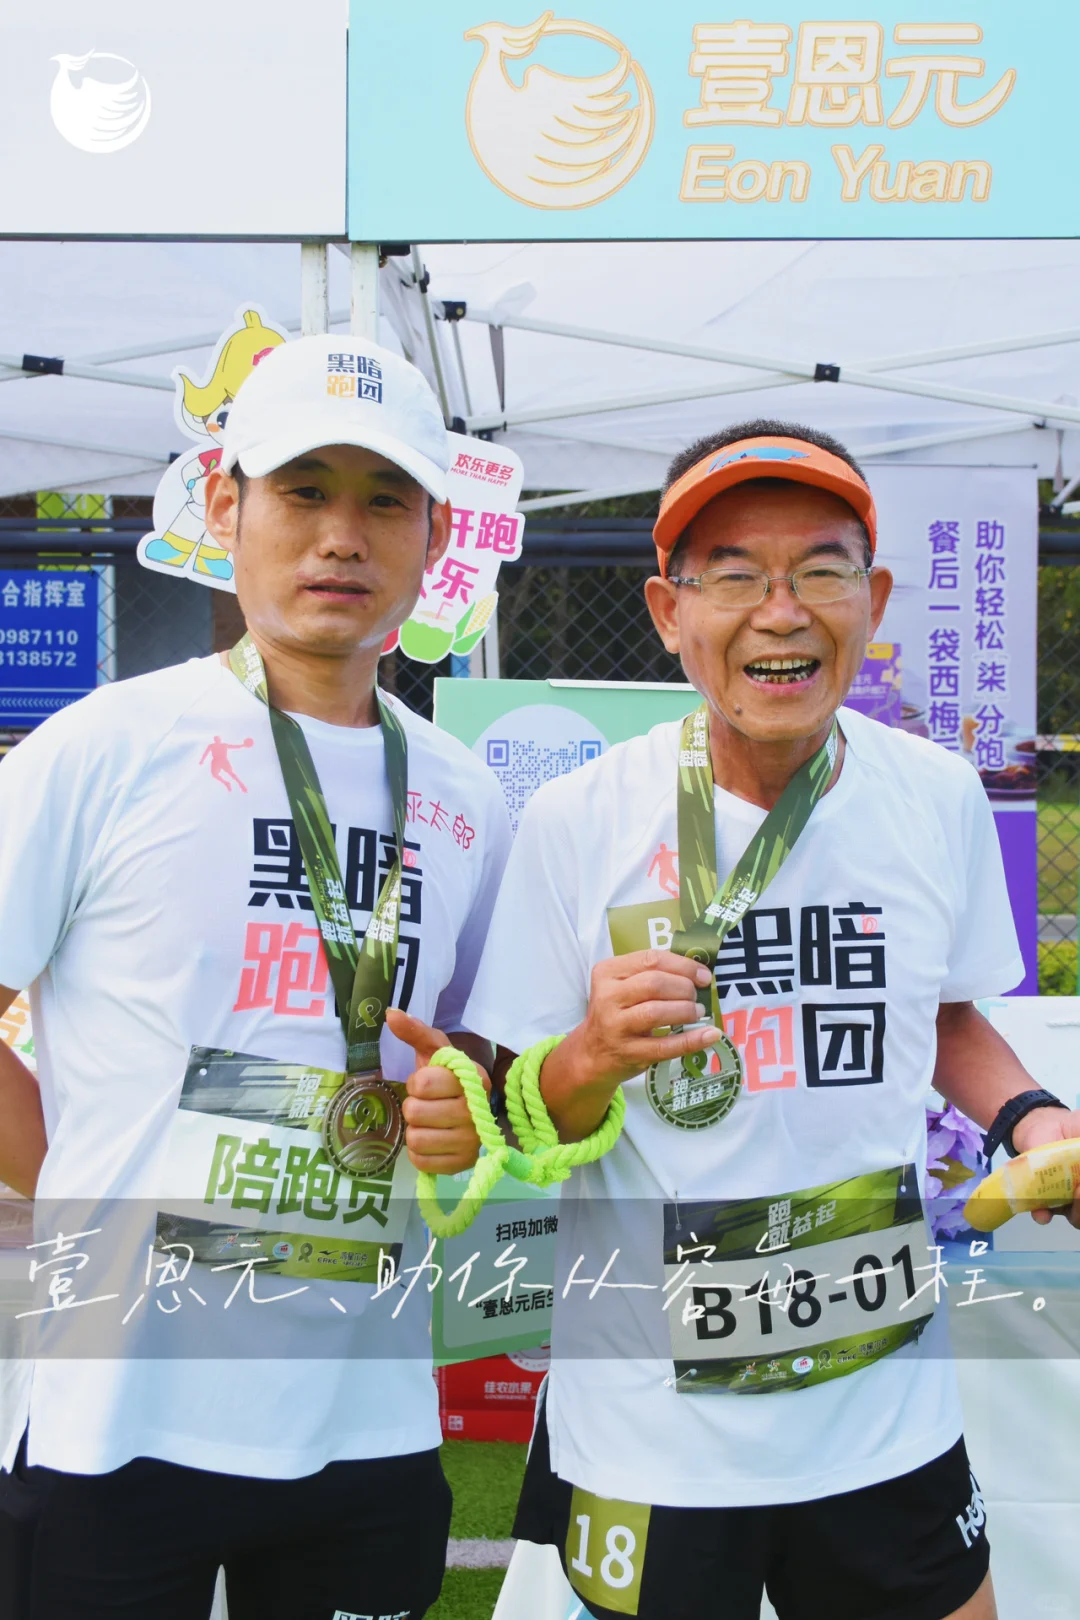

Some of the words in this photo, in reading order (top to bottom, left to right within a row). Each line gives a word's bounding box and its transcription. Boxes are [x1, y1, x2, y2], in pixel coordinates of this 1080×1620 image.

[683, 19, 1016, 129] 壹恩元
[679, 144, 811, 202] Eon
[831, 144, 992, 202] Yuan
[327, 353, 382, 380] 黑暗
[327, 375, 382, 404] 跑团
[450, 466, 469, 477] MORE
[469, 472, 487, 482] THAN
[487, 476, 509, 487] HAPPY
[454, 453, 515, 481] 欢乐更多
[420, 557, 479, 604] 乐
[975, 520, 1006, 769] 助你轻松柒分饱
[716, 902, 886, 999] 黑暗
[204, 1133, 393, 1228] 陪跑员
[496, 1215, 559, 1242] 扫码加微
[692, 1244, 917, 1340] B18-01
[571, 1513, 637, 1588] 18
